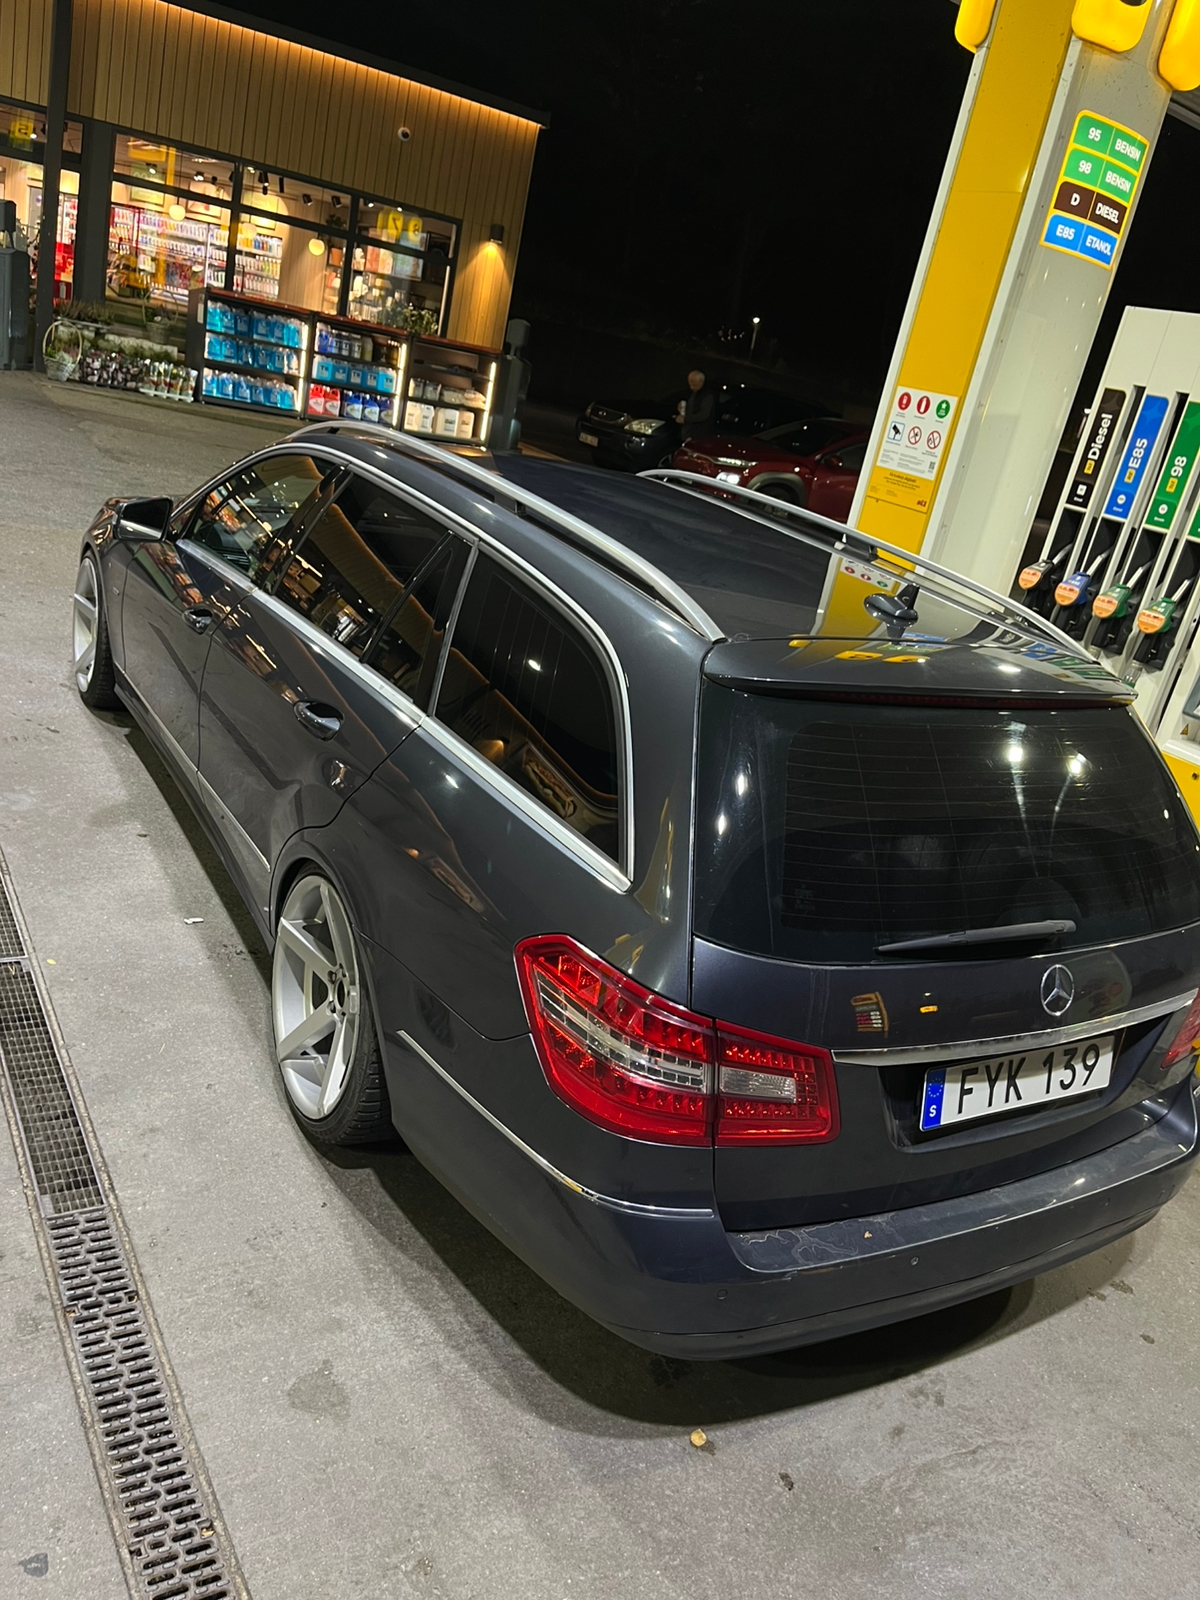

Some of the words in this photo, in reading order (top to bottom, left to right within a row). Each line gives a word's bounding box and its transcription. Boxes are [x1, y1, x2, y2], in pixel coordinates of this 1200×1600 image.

[1087, 126, 1102, 142] 95
[1115, 139, 1141, 161] BENSIN
[1078, 160, 1092, 174] 98
[1105, 171, 1132, 193] BENSIN
[1070, 193, 1081, 206] D
[1095, 202, 1119, 224] DIESEL
[1056, 224, 1075, 241] E85
[1085, 235, 1112, 255] ETANOL
[1087, 413, 1113, 461] Diesel
[1128, 438, 1148, 469] E85
[1170, 456, 1188, 477] 98
[929, 1104, 937, 1118] S
[957, 1057, 1027, 1115] FYK
[1042, 1043, 1100, 1095] 139
